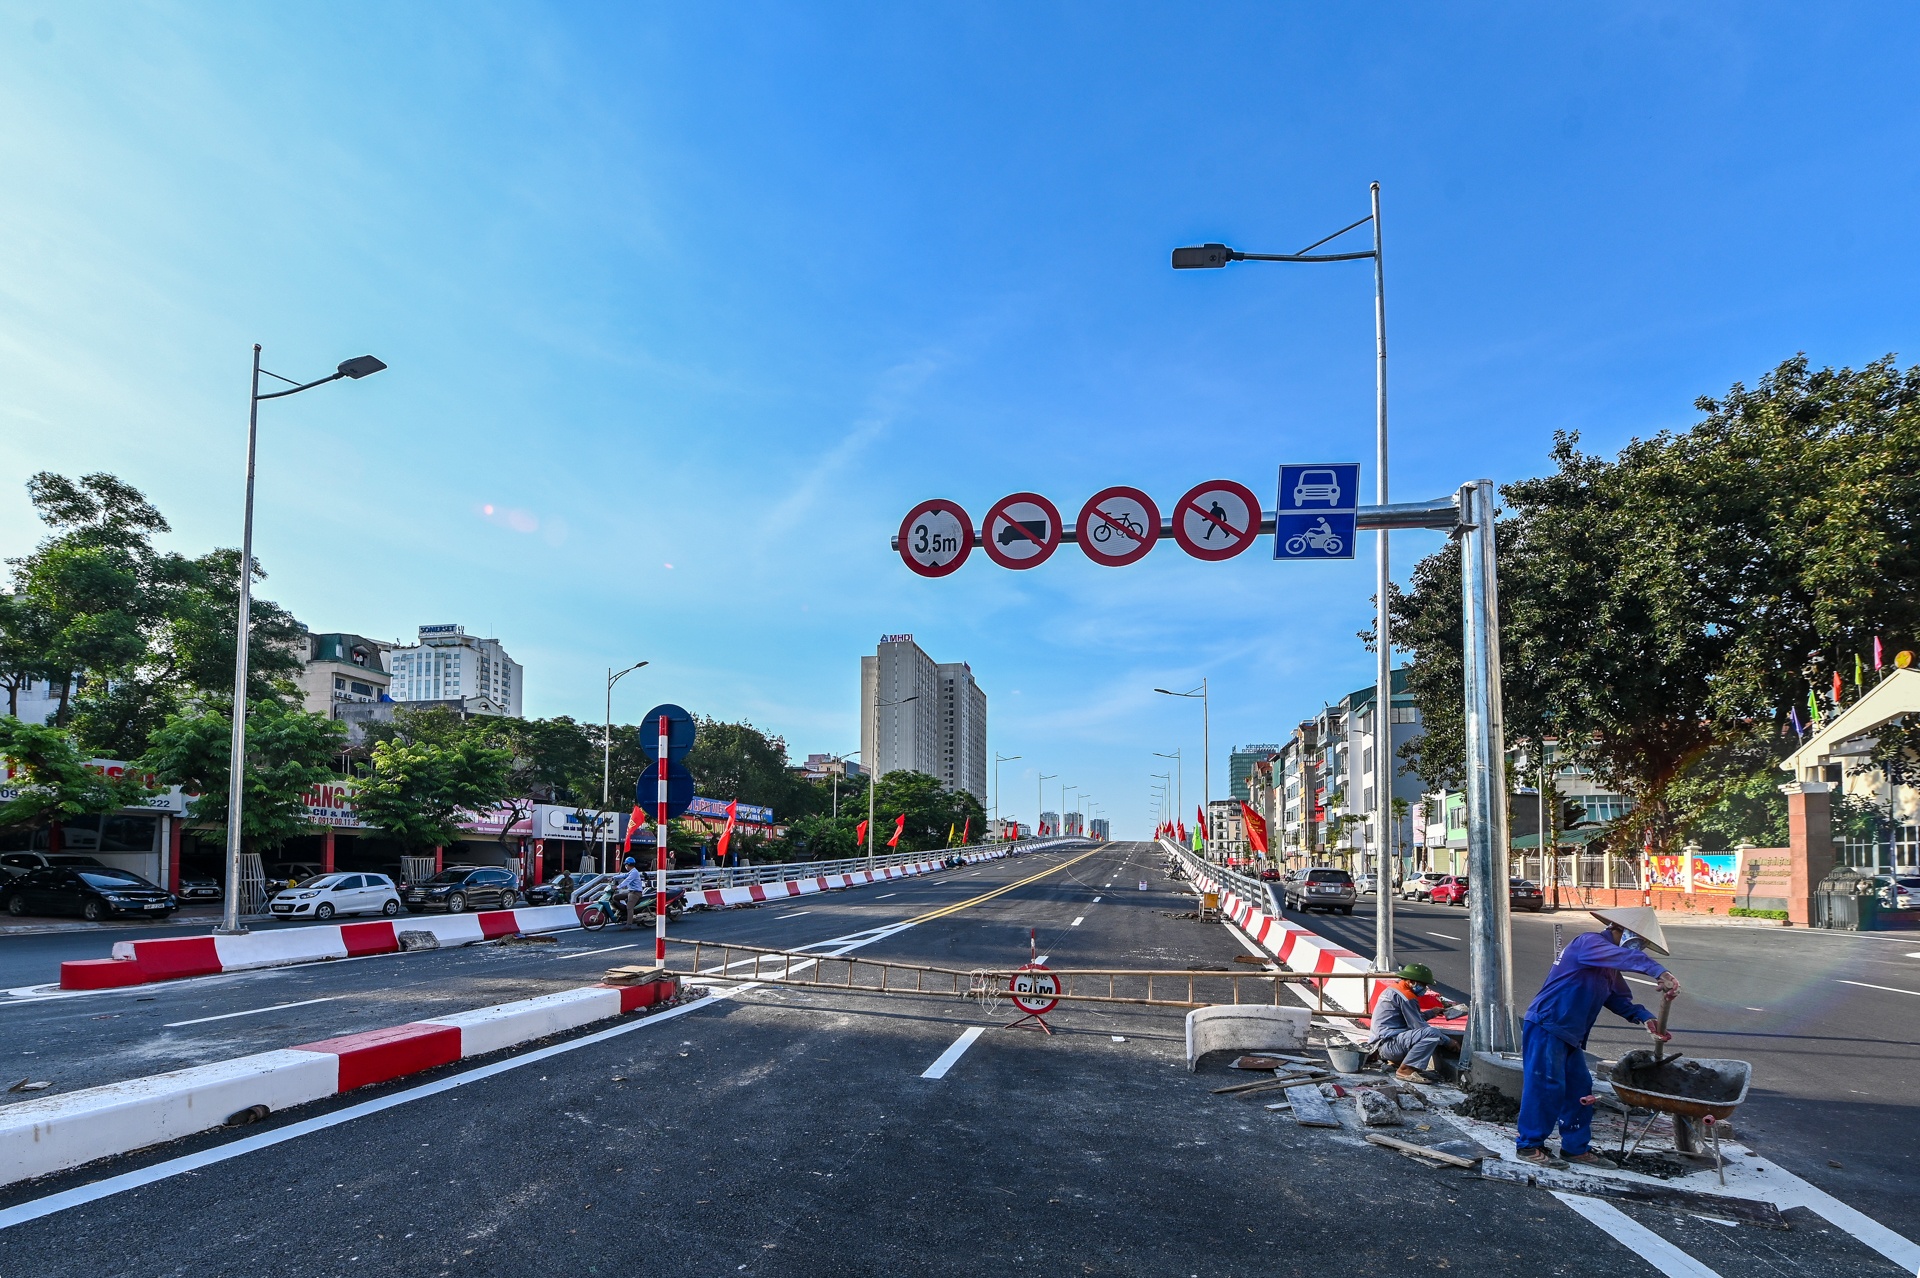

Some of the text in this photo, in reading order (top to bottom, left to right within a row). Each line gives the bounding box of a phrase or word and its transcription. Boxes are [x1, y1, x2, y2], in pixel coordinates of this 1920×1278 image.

[914, 524, 957, 555] 3,5m
[890, 634, 913, 643] MHDI
[536, 844, 543, 857] 2
[615, 849, 620, 861] 2
